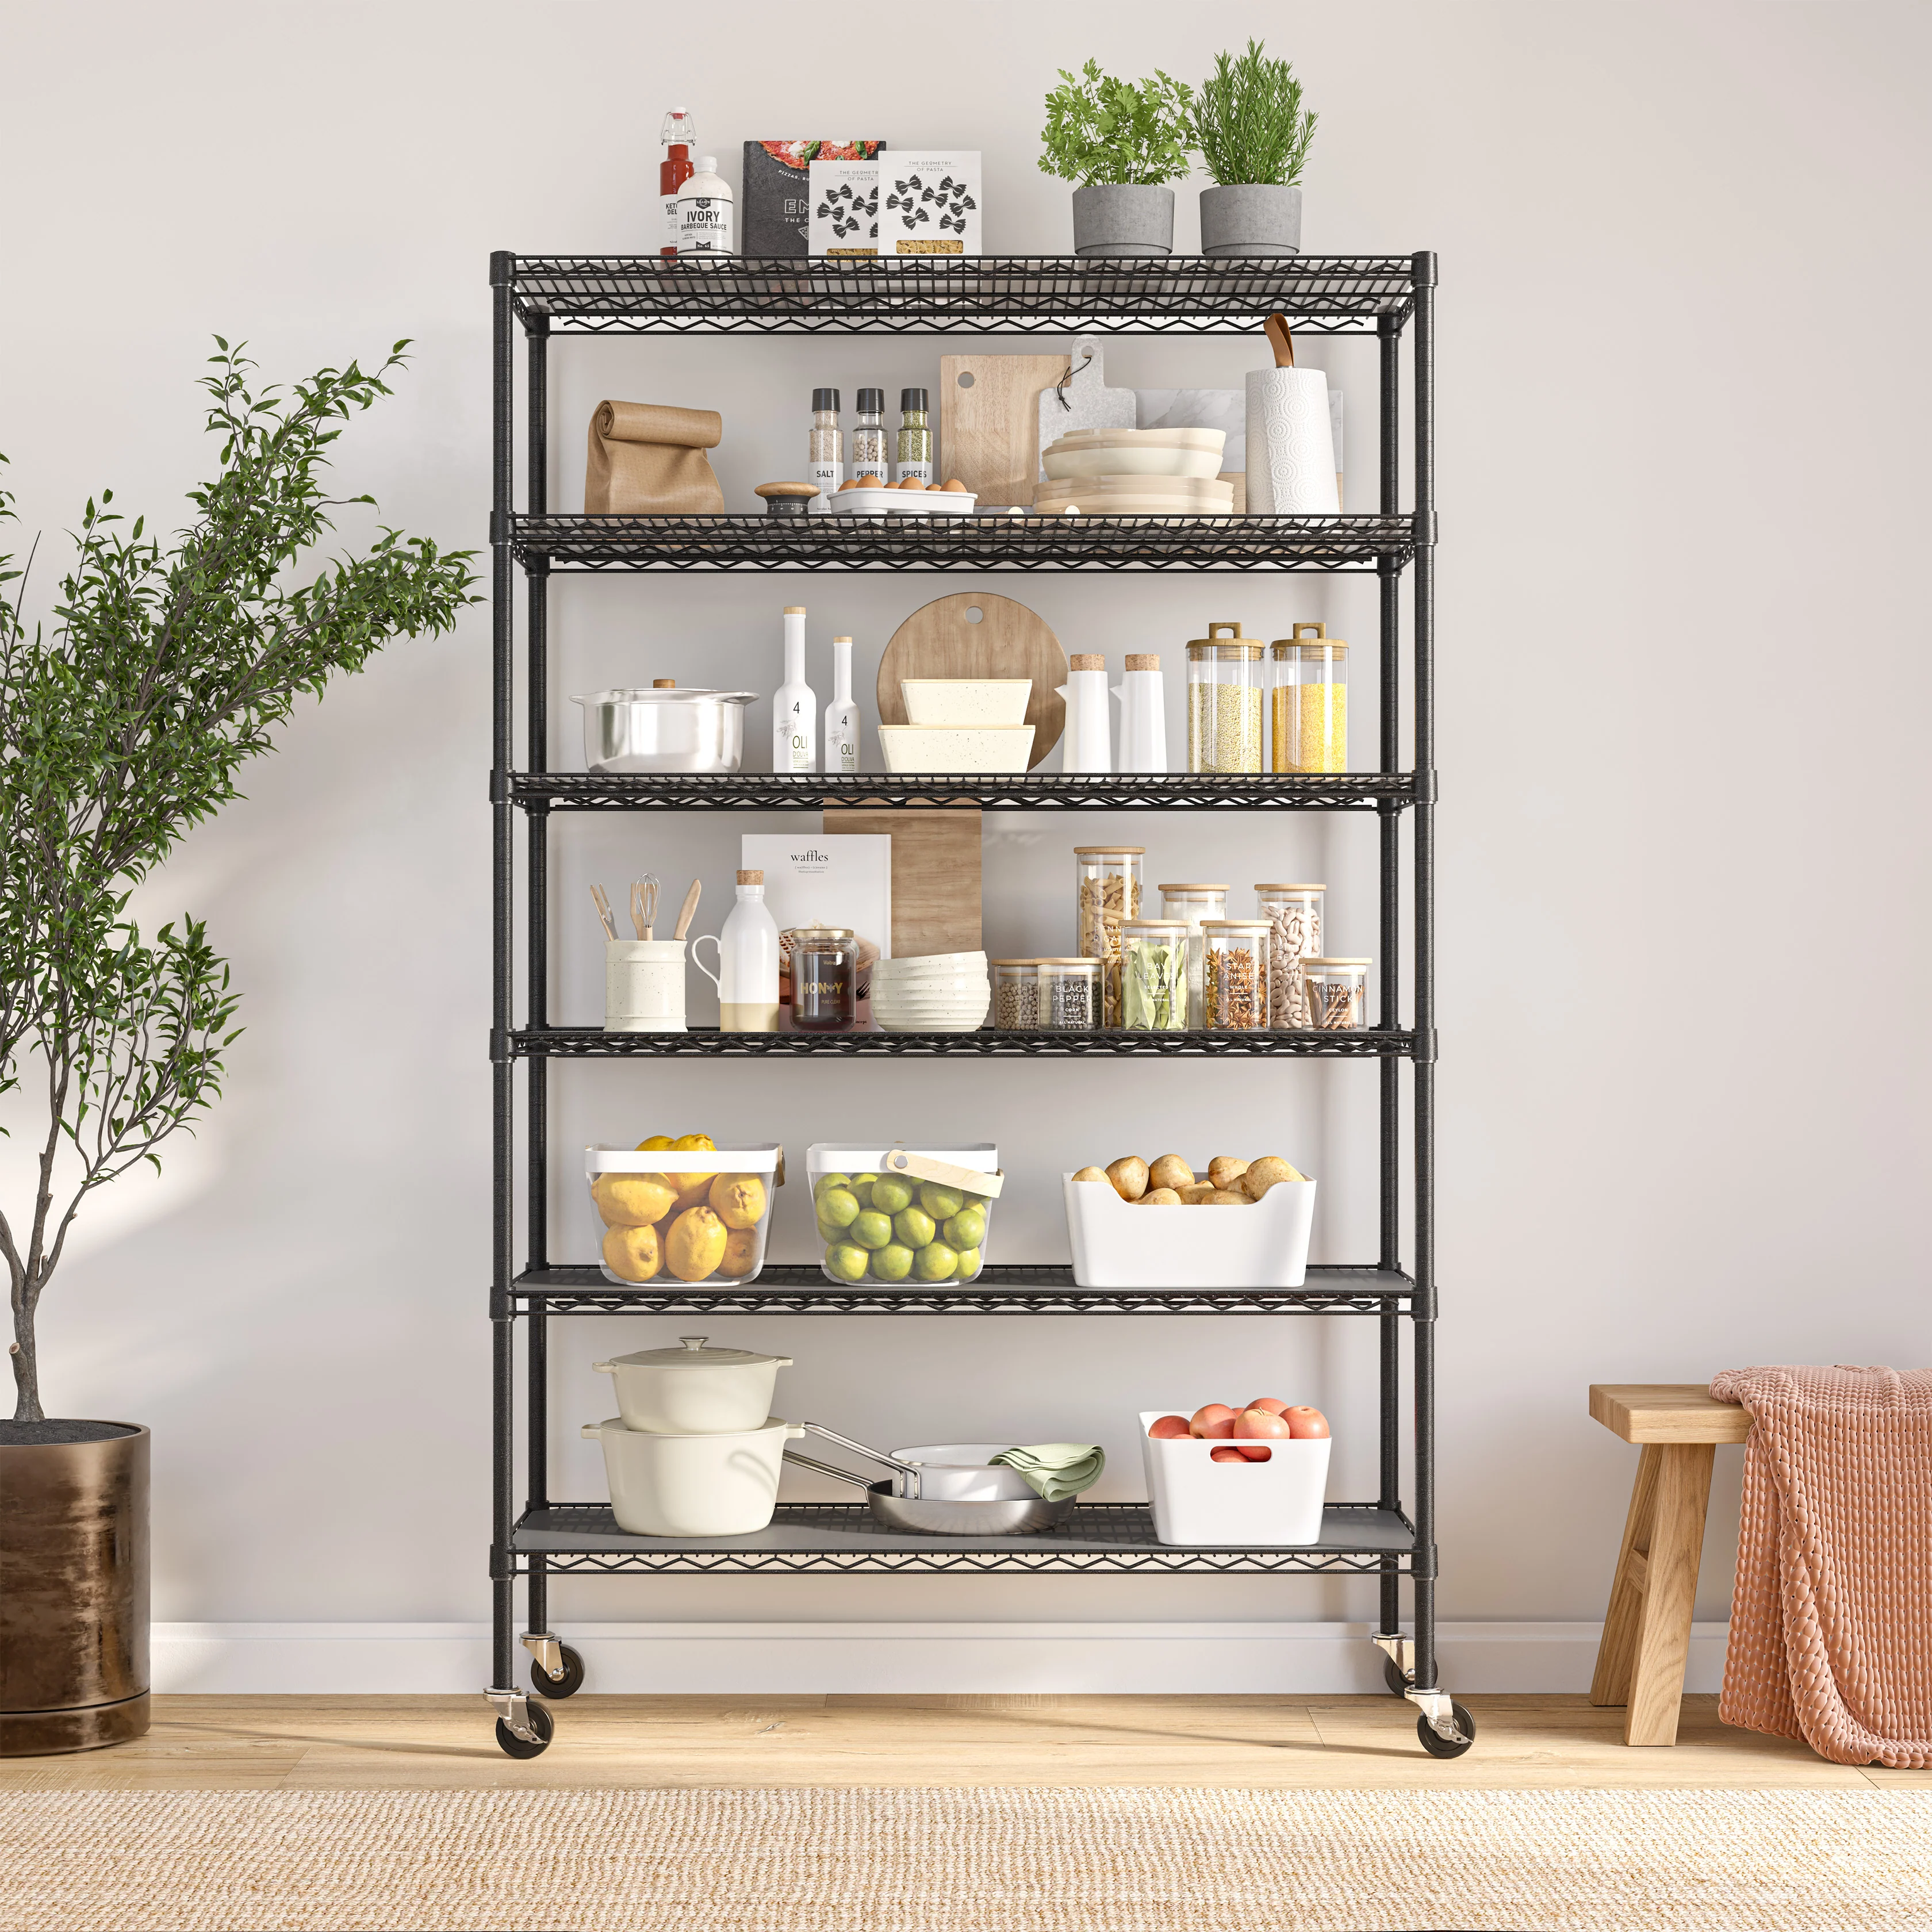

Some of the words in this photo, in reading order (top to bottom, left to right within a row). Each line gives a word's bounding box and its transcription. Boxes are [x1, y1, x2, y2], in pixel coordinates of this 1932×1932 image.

[687, 210, 720, 223] IVORY
[681, 223, 708, 231] BARBEQUE
[710, 223, 727, 231] SAUCE
[857, 470, 883, 478] PEPPER
[793, 702, 800, 714] 4
[841, 715, 848, 726] 4
[792, 735, 807, 749] OLI
[841, 743, 854, 755] OLI
[790, 850, 829, 862] waffles
[800, 982, 843, 994] HONY
